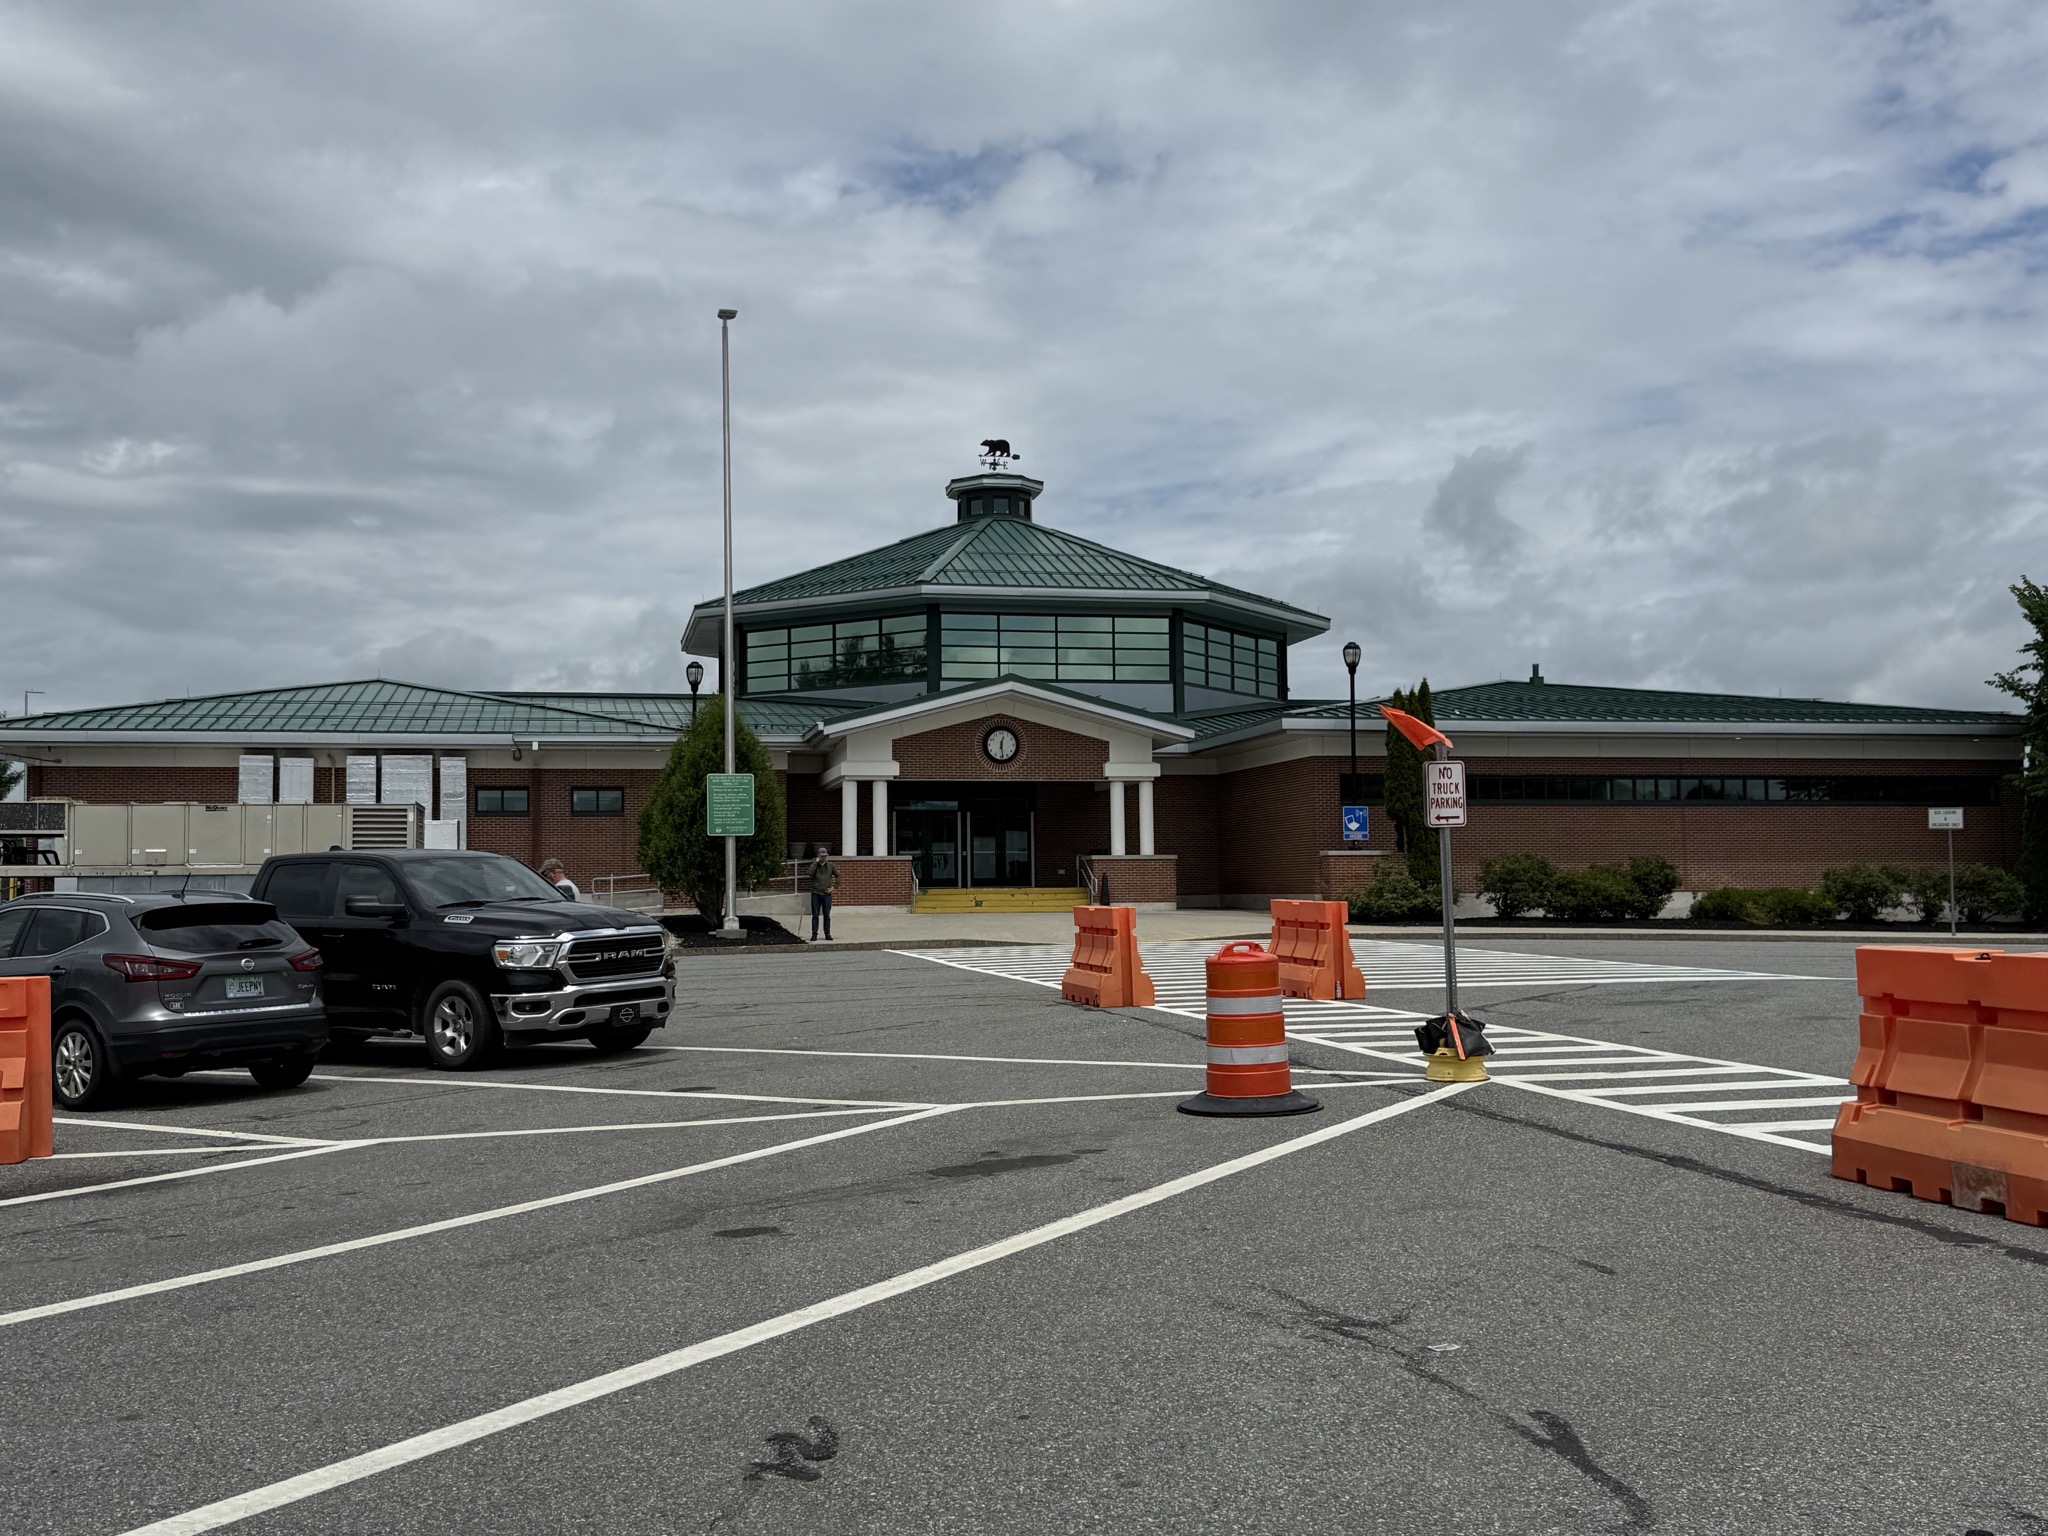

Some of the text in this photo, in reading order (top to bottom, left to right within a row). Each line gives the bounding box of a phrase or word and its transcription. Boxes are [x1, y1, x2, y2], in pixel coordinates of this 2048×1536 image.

[1438, 767, 1453, 780] NO
[1432, 782, 1460, 795] TRUCK
[1430, 797, 1463, 810] PARKING
[603, 949, 643, 960] RAM
[237, 981, 262, 992] JEEPNY
